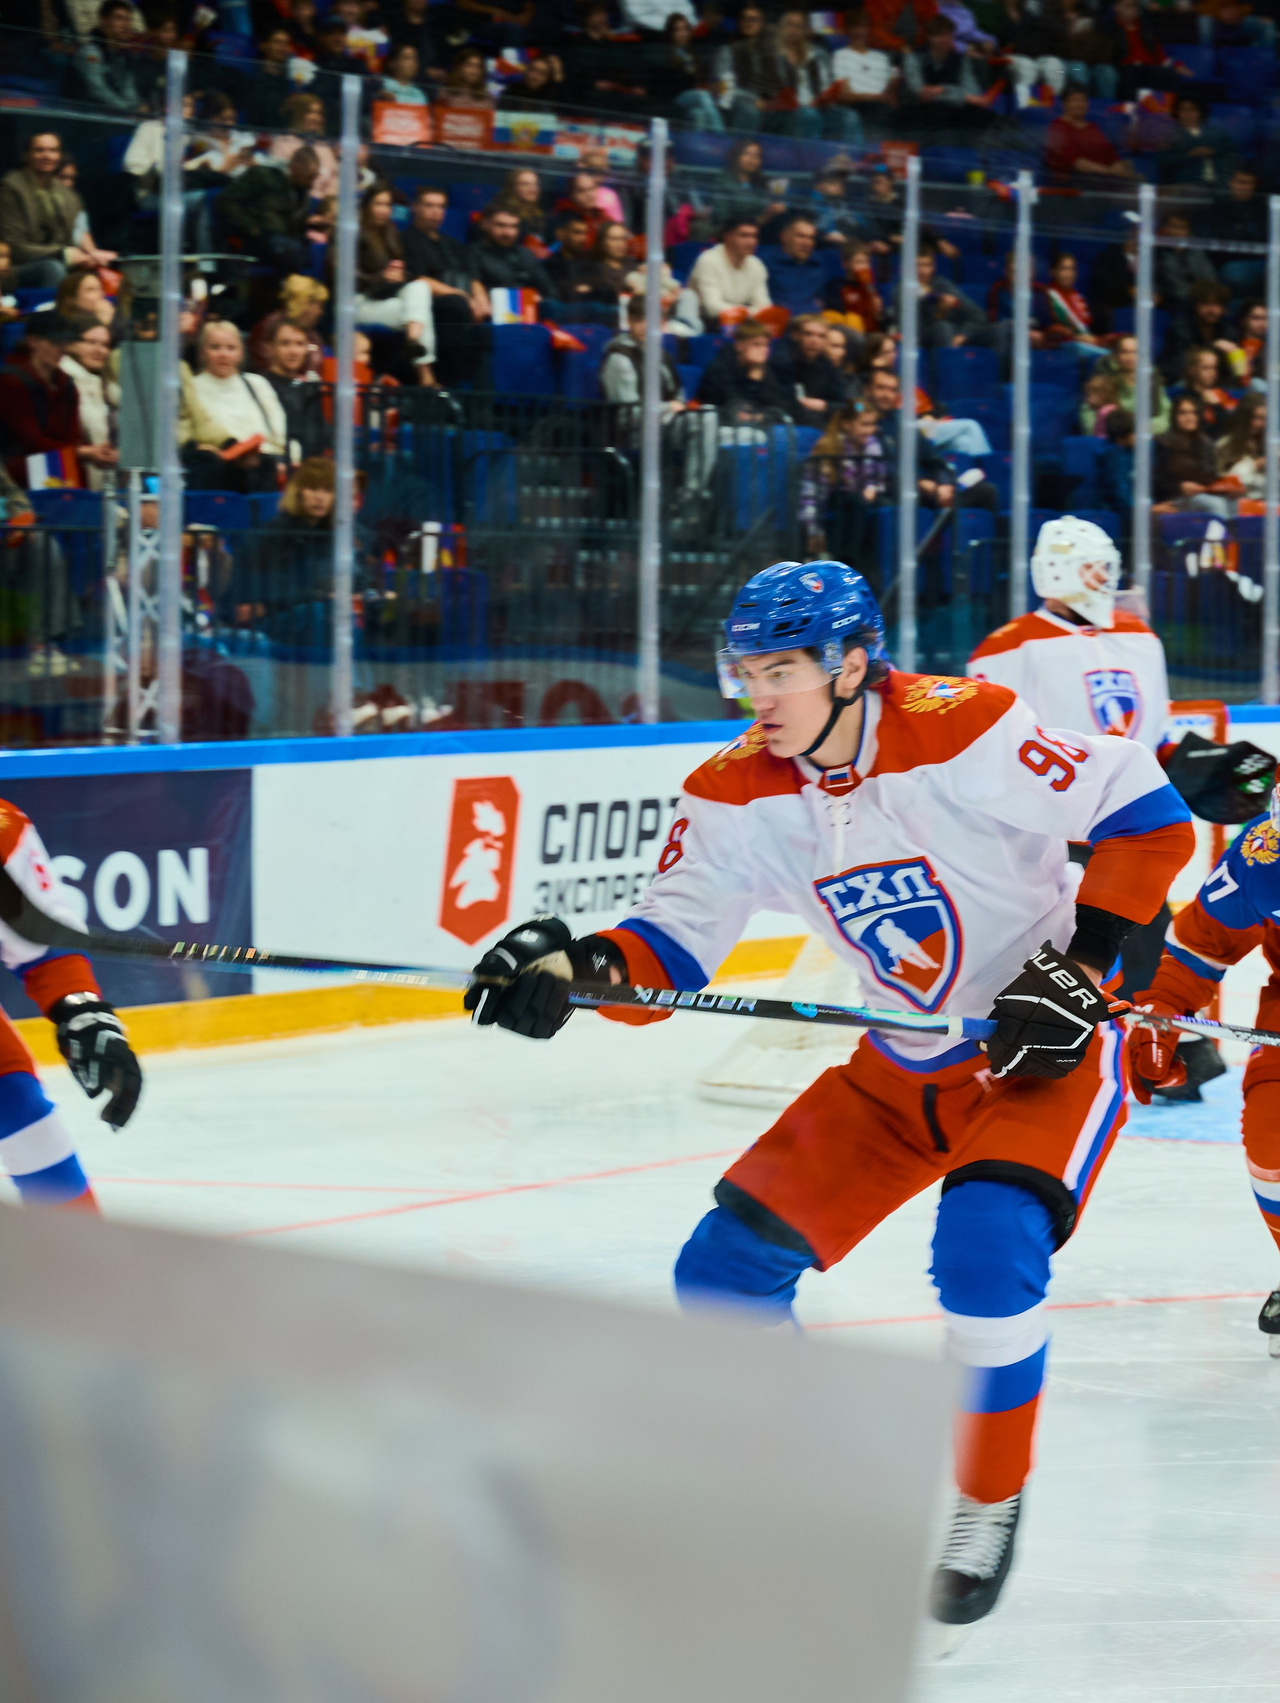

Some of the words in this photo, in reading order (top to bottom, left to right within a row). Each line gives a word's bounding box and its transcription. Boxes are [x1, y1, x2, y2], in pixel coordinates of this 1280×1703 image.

[534, 871, 658, 915] ЭКСПРЕ
[818, 866, 940, 920] СХЛ
[1205, 860, 1240, 903] 17
